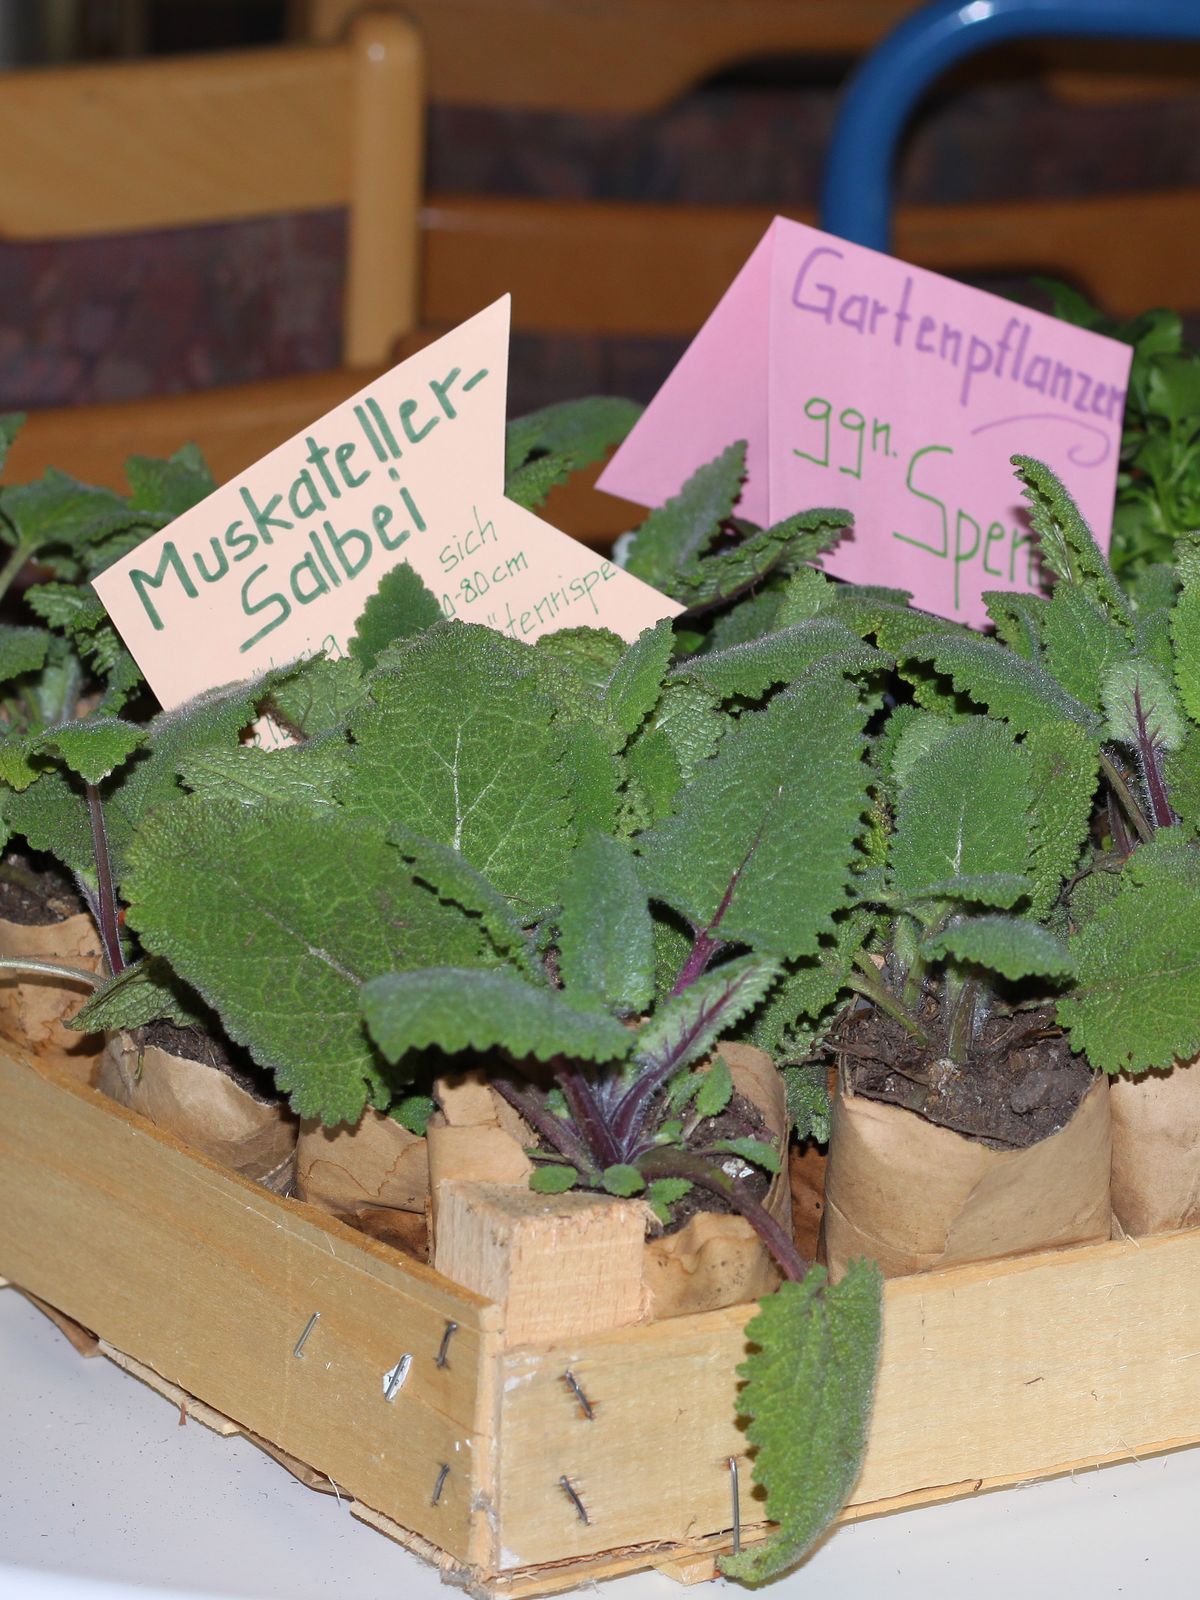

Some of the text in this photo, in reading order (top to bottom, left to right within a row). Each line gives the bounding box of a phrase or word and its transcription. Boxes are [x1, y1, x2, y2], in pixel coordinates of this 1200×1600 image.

[791, 247, 1127, 427] Gartenpflanzen
[128, 366, 490, 631] Muskateller-
[239, 467, 427, 654] Salbei
[439, 505, 498, 573] sich
[442, 551, 528, 619] 0-80cm
[793, 397, 1044, 611] ggn. Spen
[487, 561, 618, 640] tenrispe
